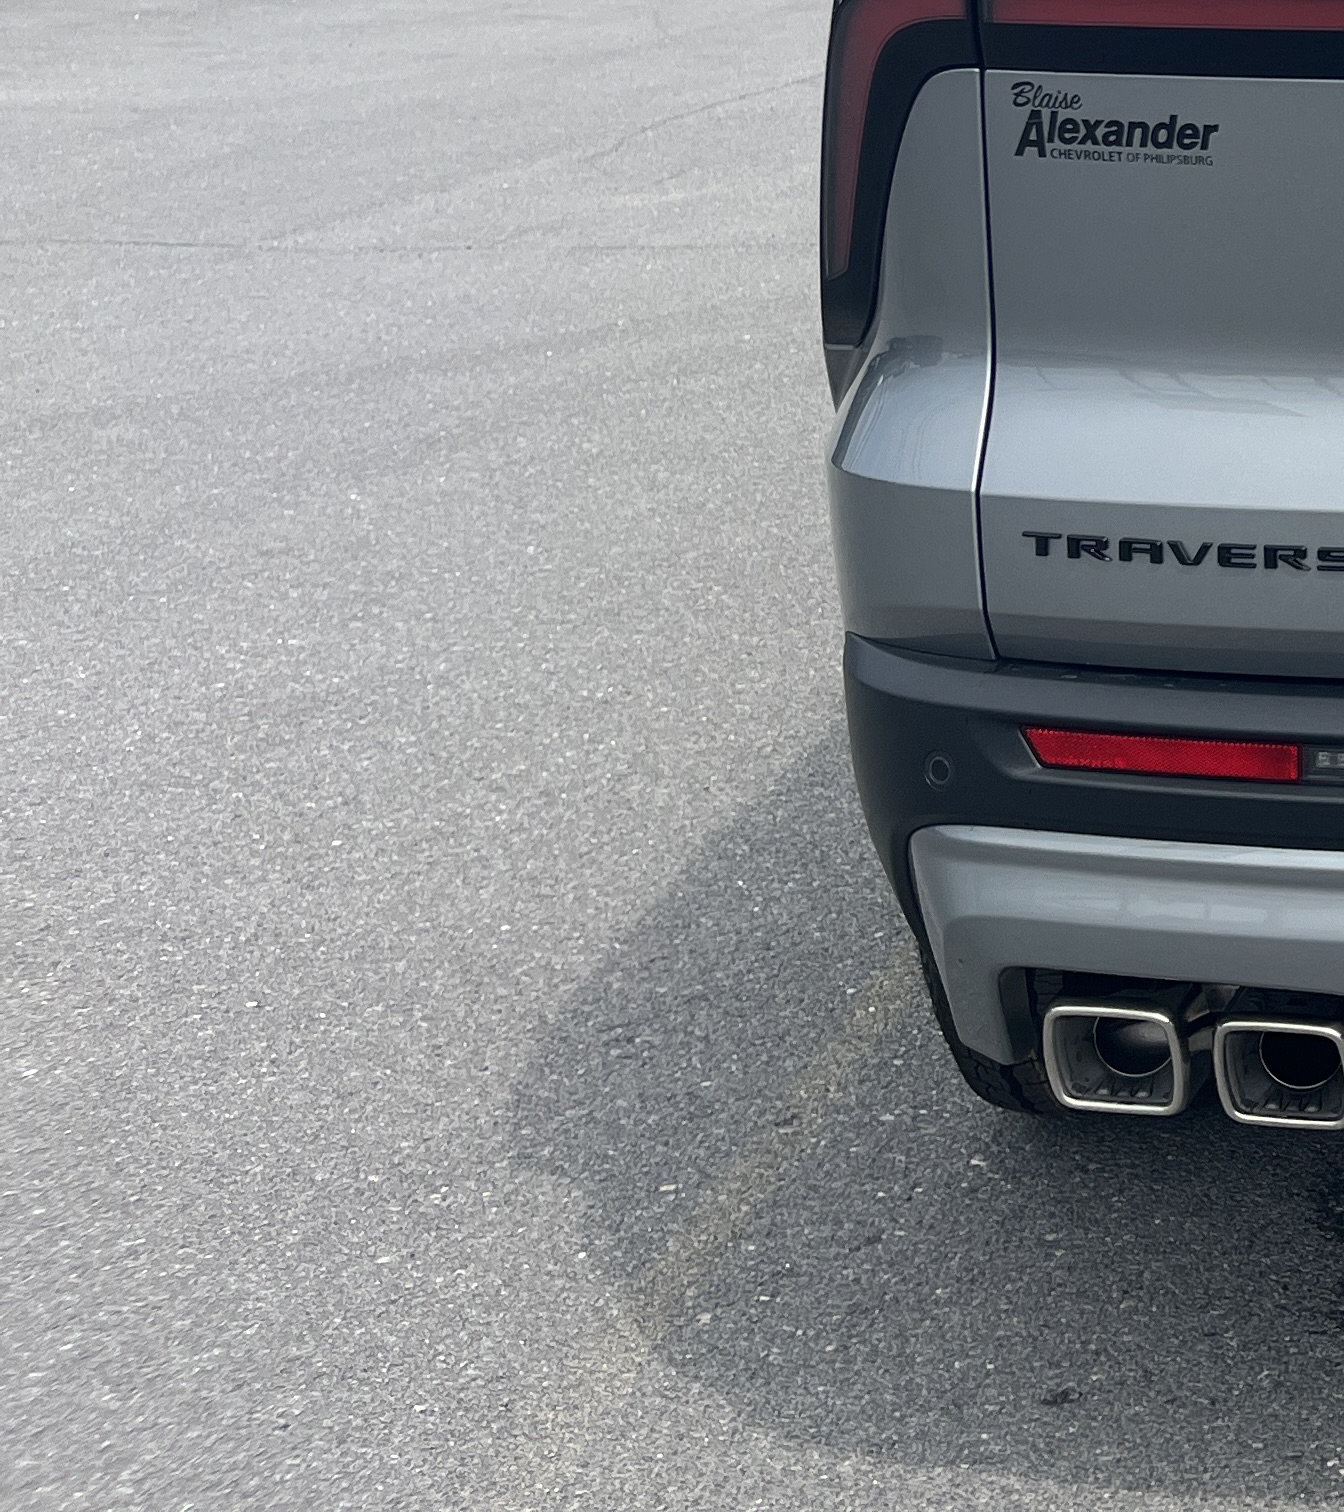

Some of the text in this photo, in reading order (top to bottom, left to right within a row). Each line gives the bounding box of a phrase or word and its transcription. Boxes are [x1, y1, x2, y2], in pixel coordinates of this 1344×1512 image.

[1011, 81, 1082, 110] Blaise
[1014, 109, 1219, 158] Alexander
[1050, 147, 1214, 167] CHEVROLET OF PHILIPSBURG
